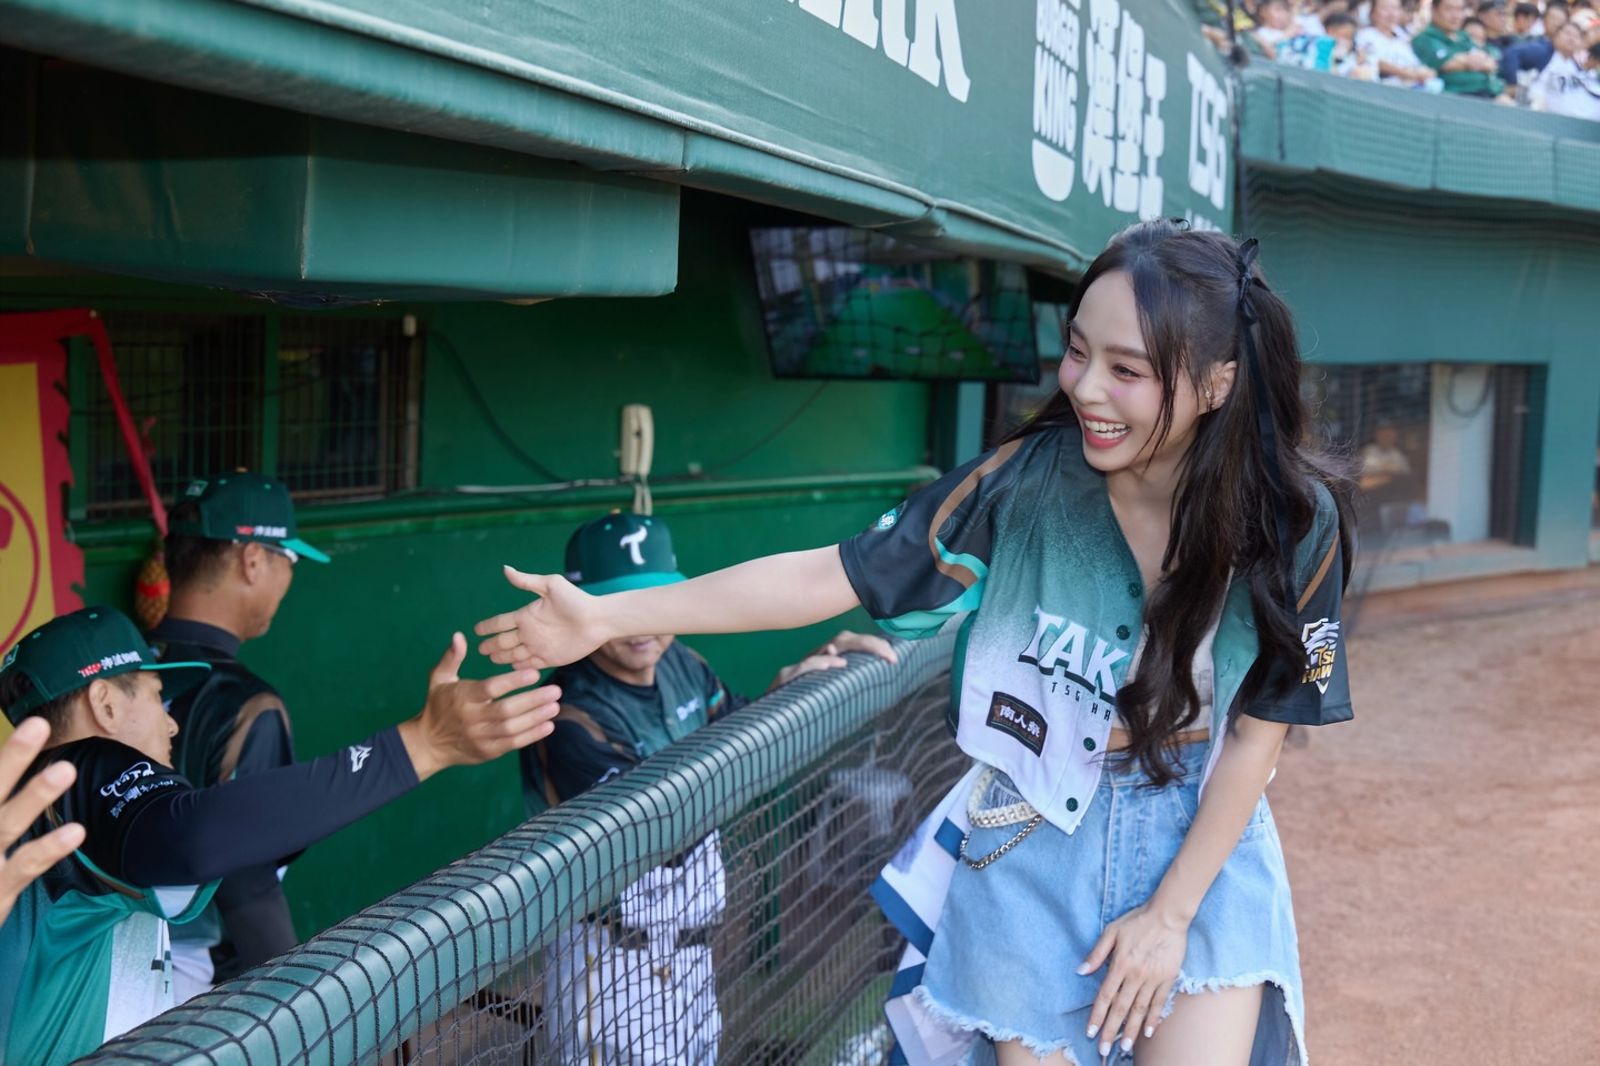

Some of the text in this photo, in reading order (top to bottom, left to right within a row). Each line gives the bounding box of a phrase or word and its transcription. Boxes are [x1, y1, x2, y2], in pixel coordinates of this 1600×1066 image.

[1033, 45, 1078, 153] KING
[1083, 0, 1166, 221] 漢堡王
[1187, 52, 1227, 210] TSG
[620, 525, 648, 566] T
[1050, 682, 1080, 702] TSG
